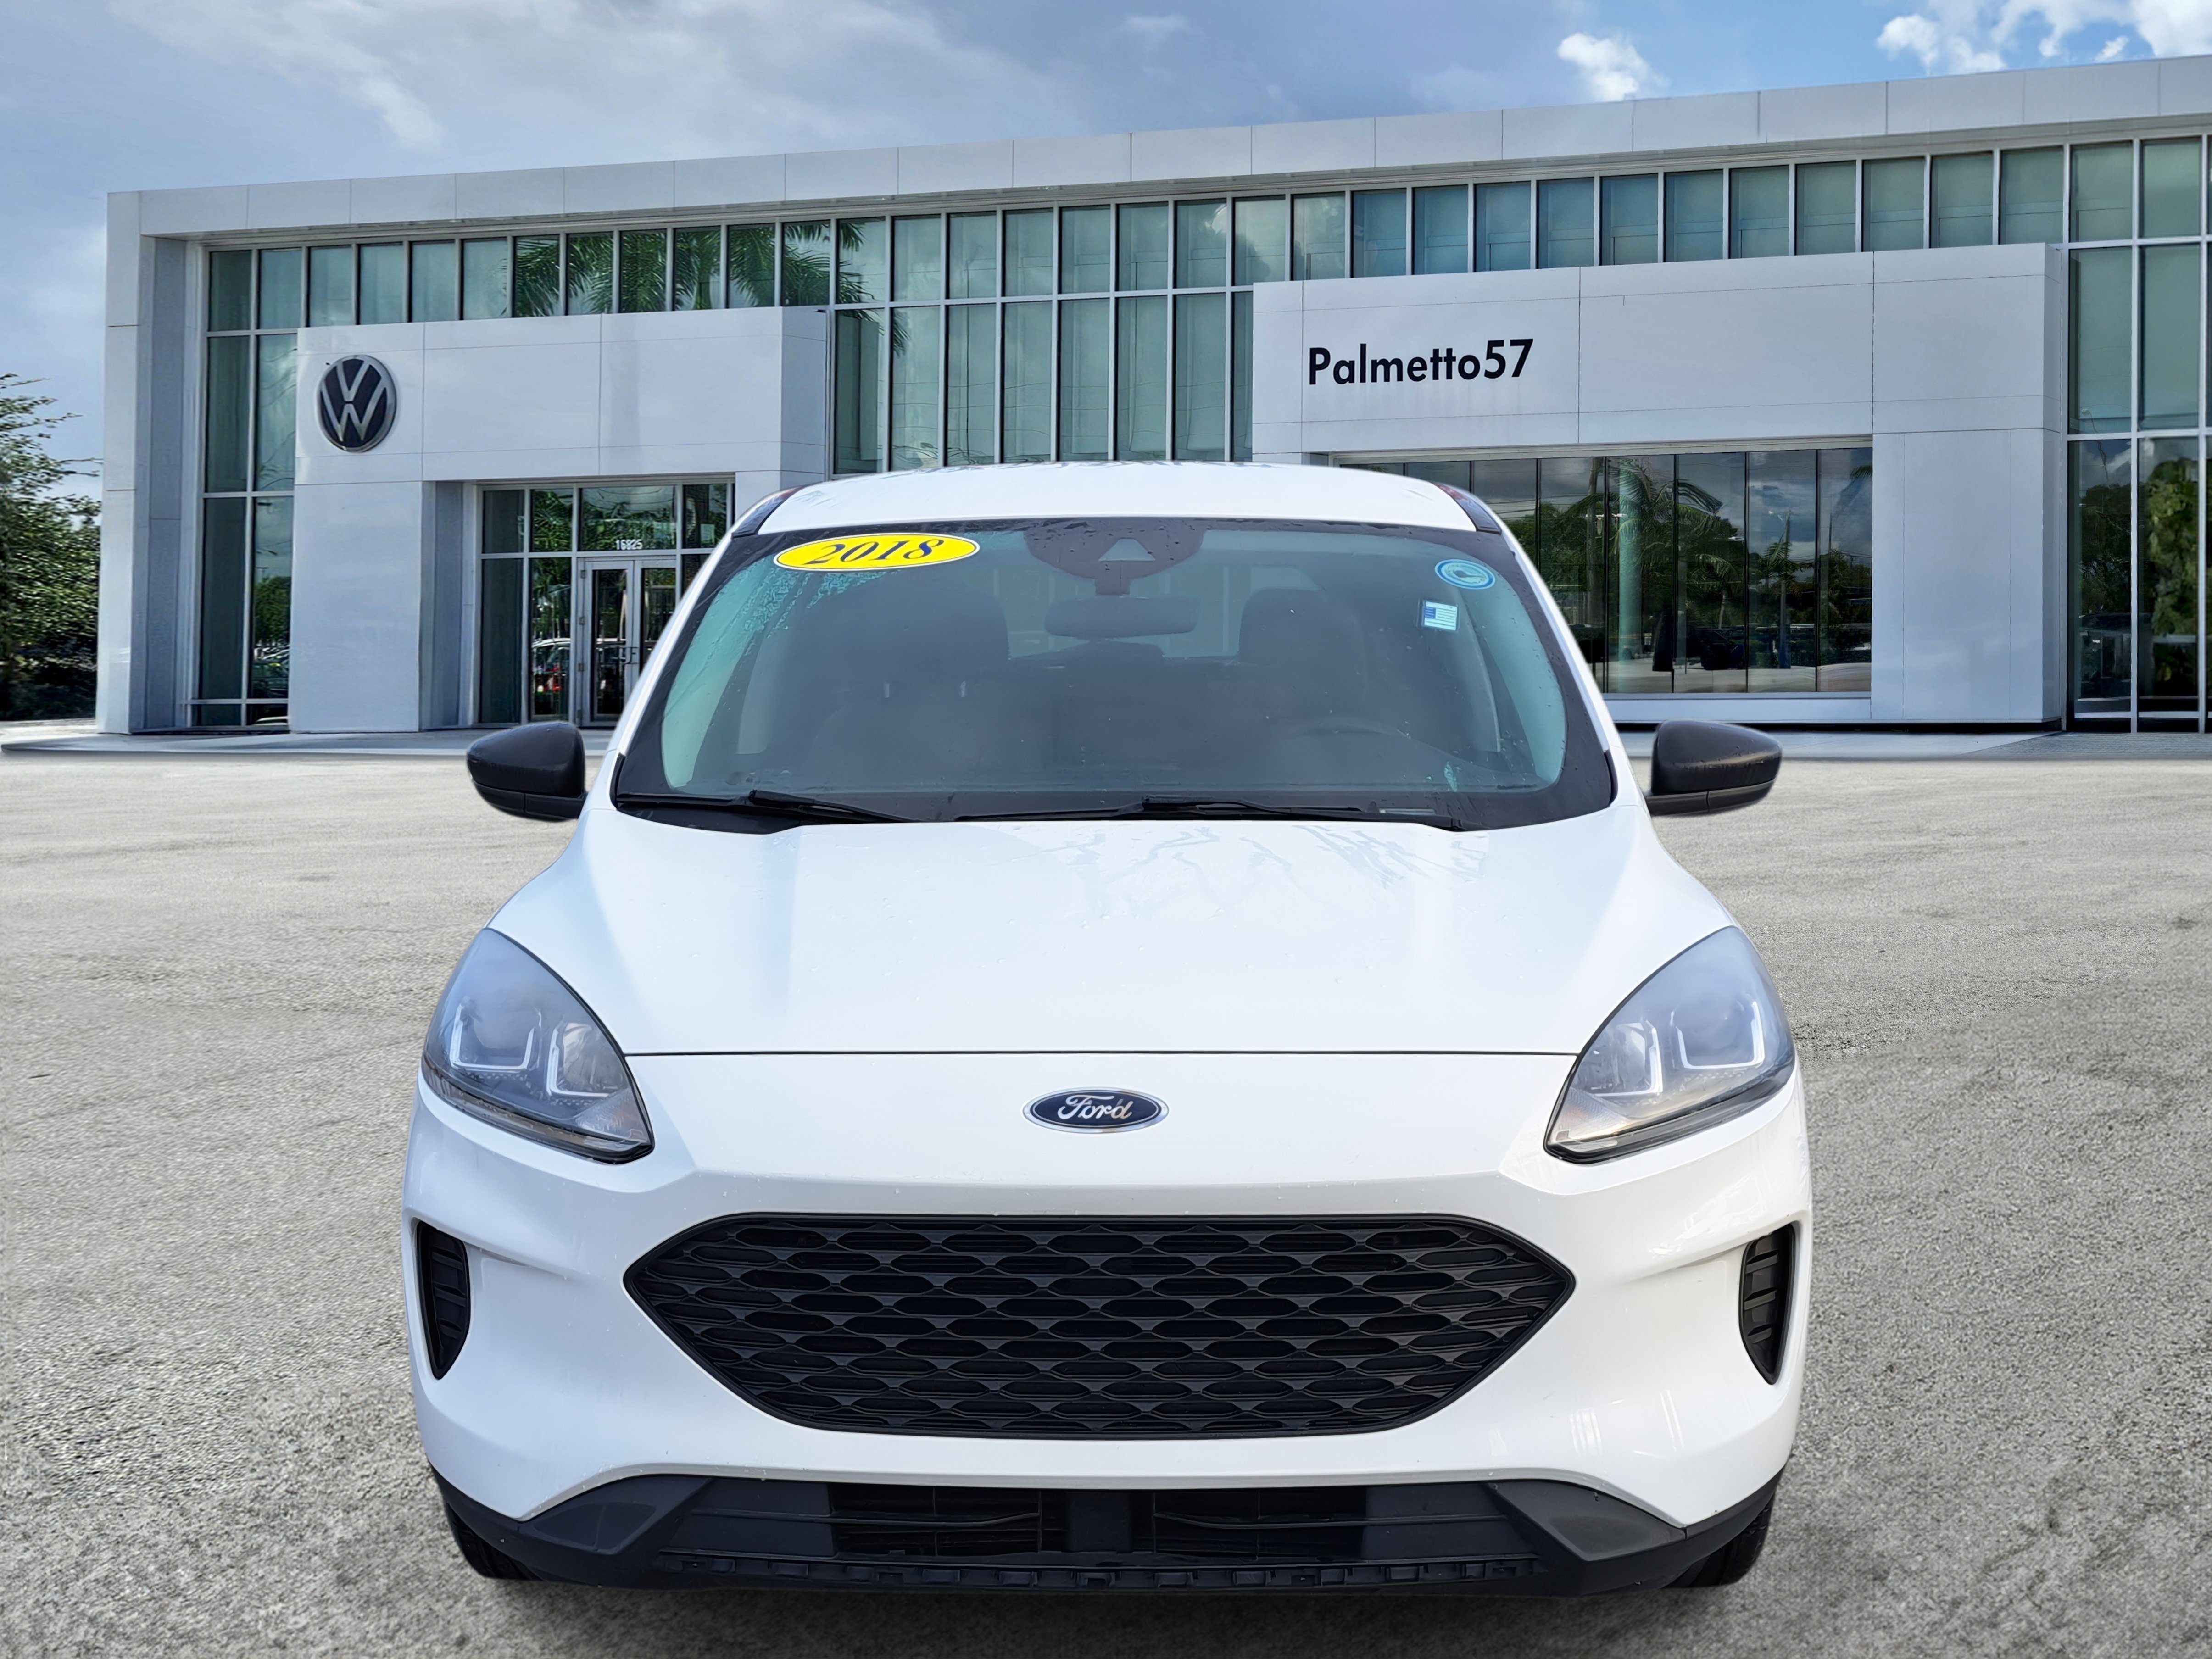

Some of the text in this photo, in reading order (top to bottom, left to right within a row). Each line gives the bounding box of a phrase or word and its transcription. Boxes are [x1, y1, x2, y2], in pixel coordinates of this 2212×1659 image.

[1309, 339, 1533, 384] Palmetto57
[320, 356, 389, 442] VW
[615, 539, 643, 550] 16825
[800, 539, 944, 565] 2018
[1057, 1094, 1134, 1119] Ford
